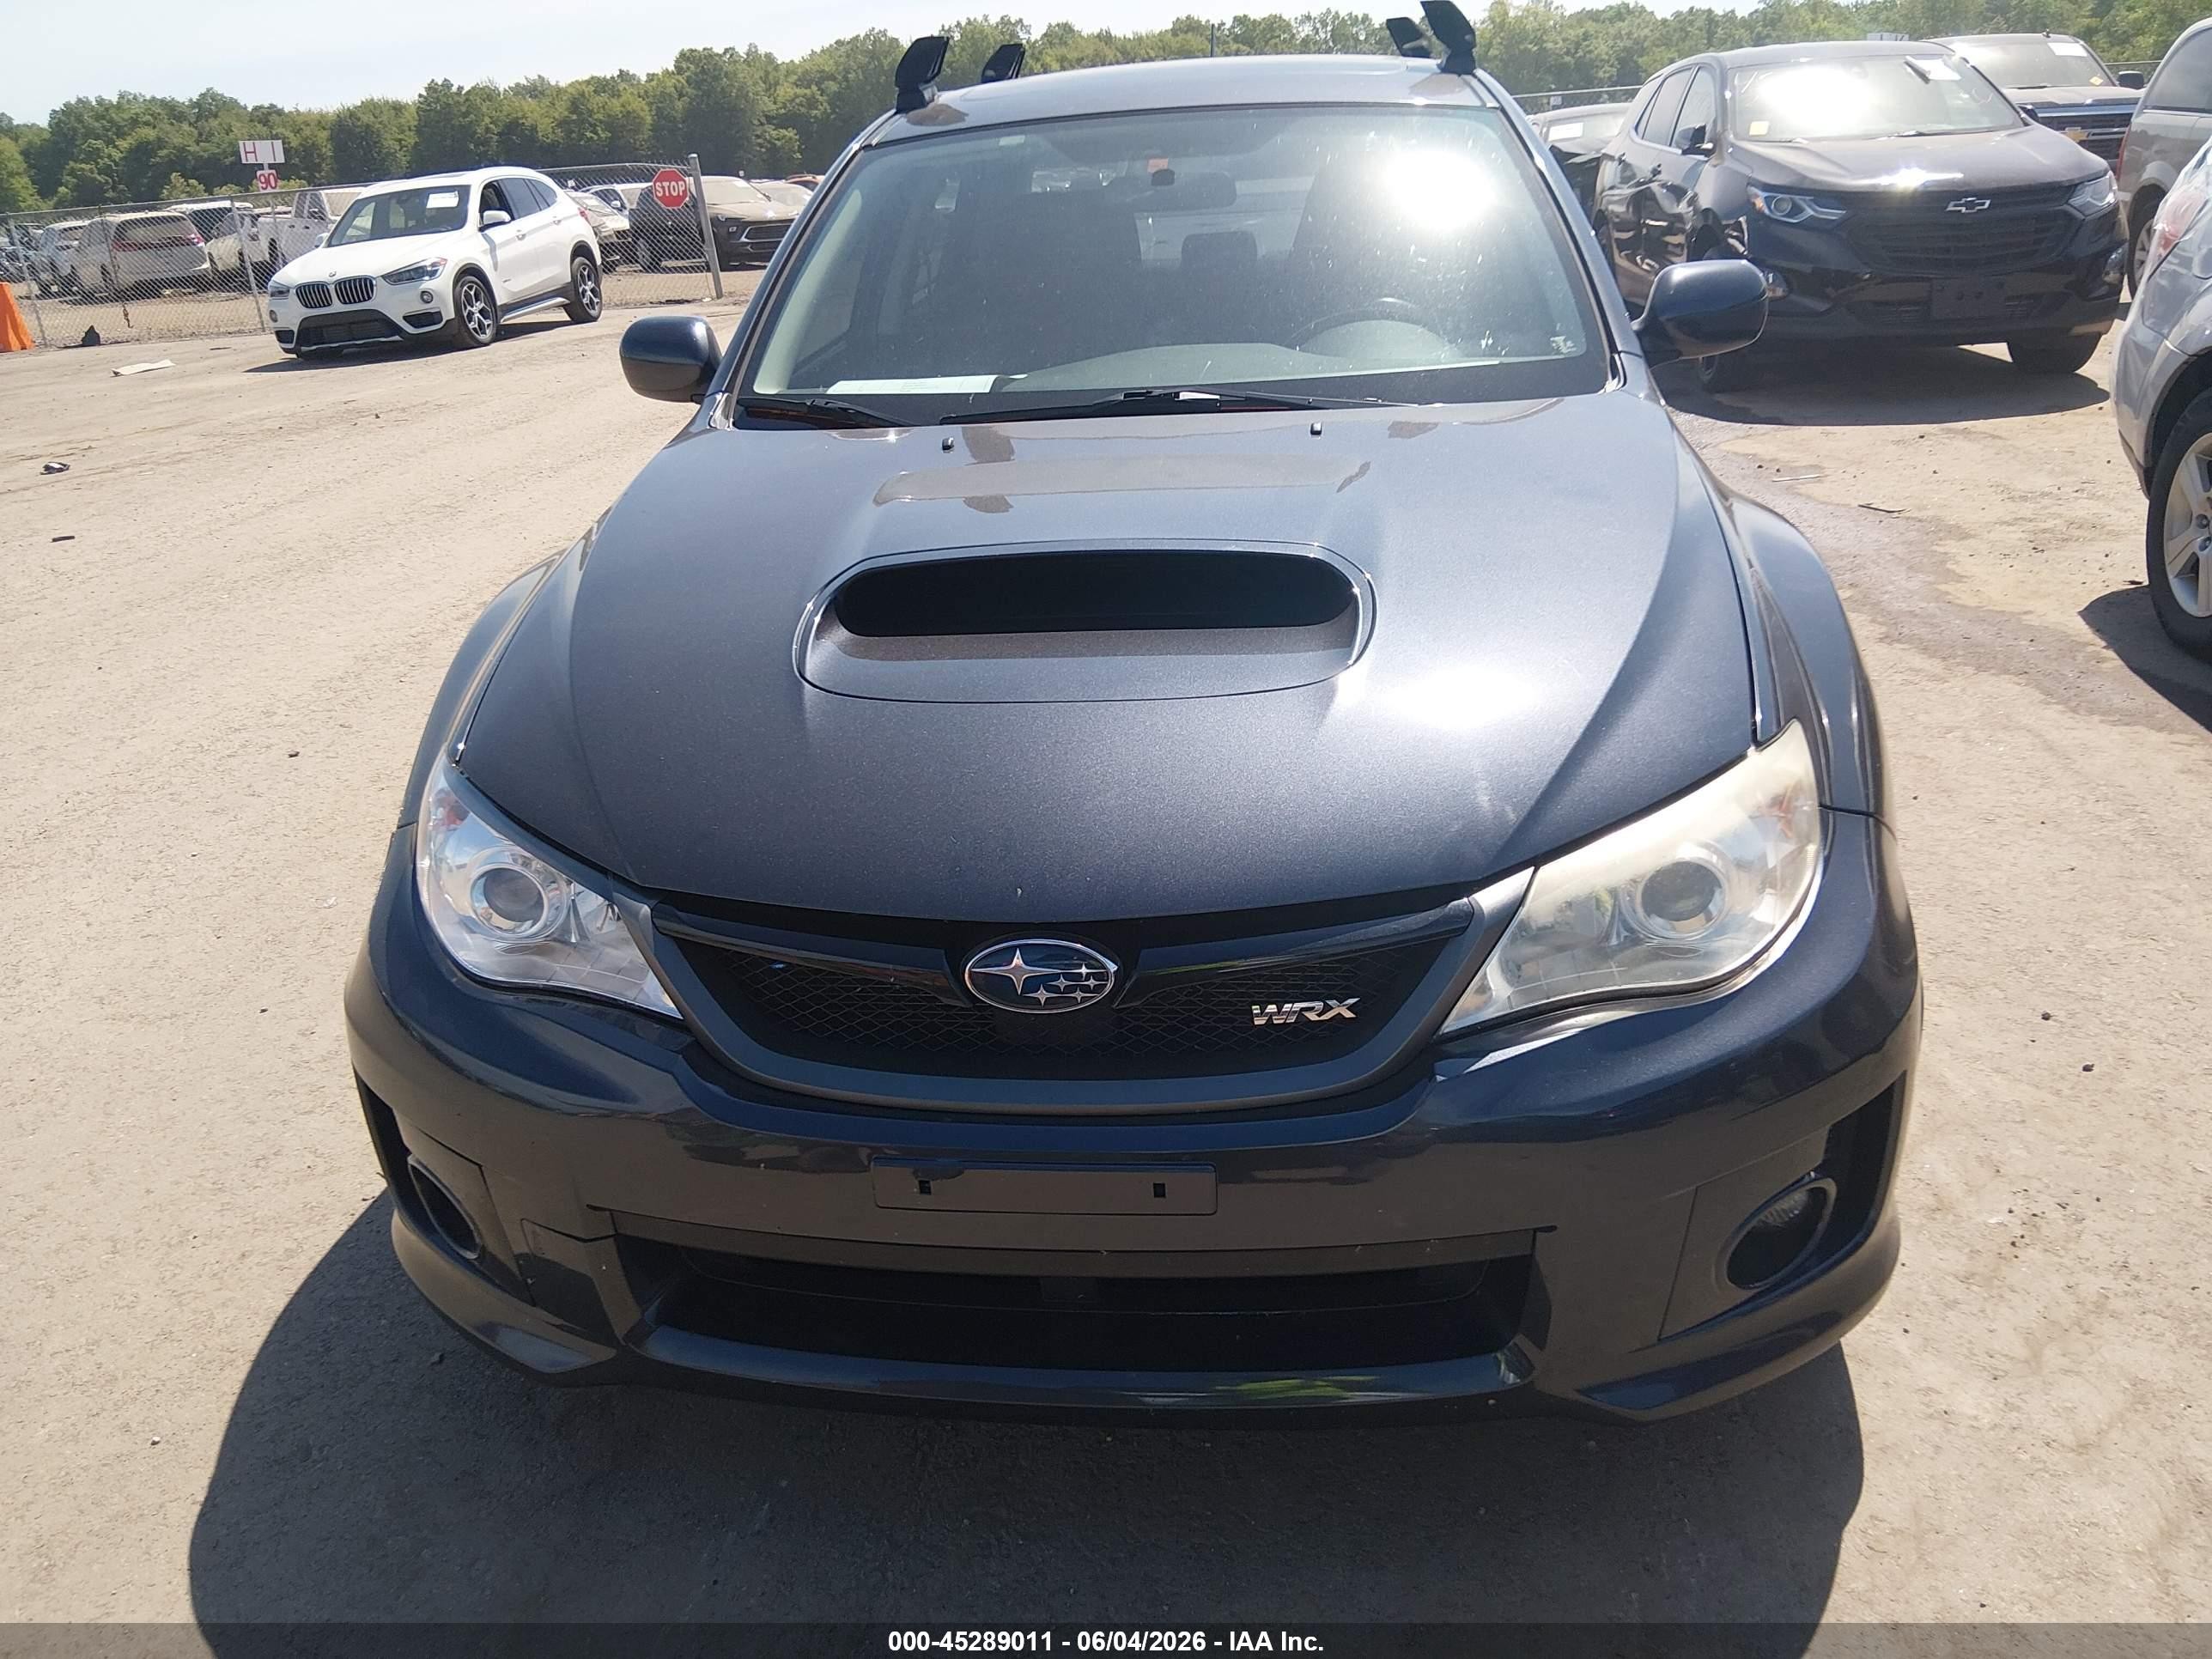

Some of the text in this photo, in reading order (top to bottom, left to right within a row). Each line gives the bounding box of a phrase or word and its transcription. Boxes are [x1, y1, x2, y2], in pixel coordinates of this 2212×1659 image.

[242, 141, 258, 162] H
[258, 173, 278, 190] 90
[655, 180, 685, 197] STOP
[1251, 997, 1361, 1025] WRX
